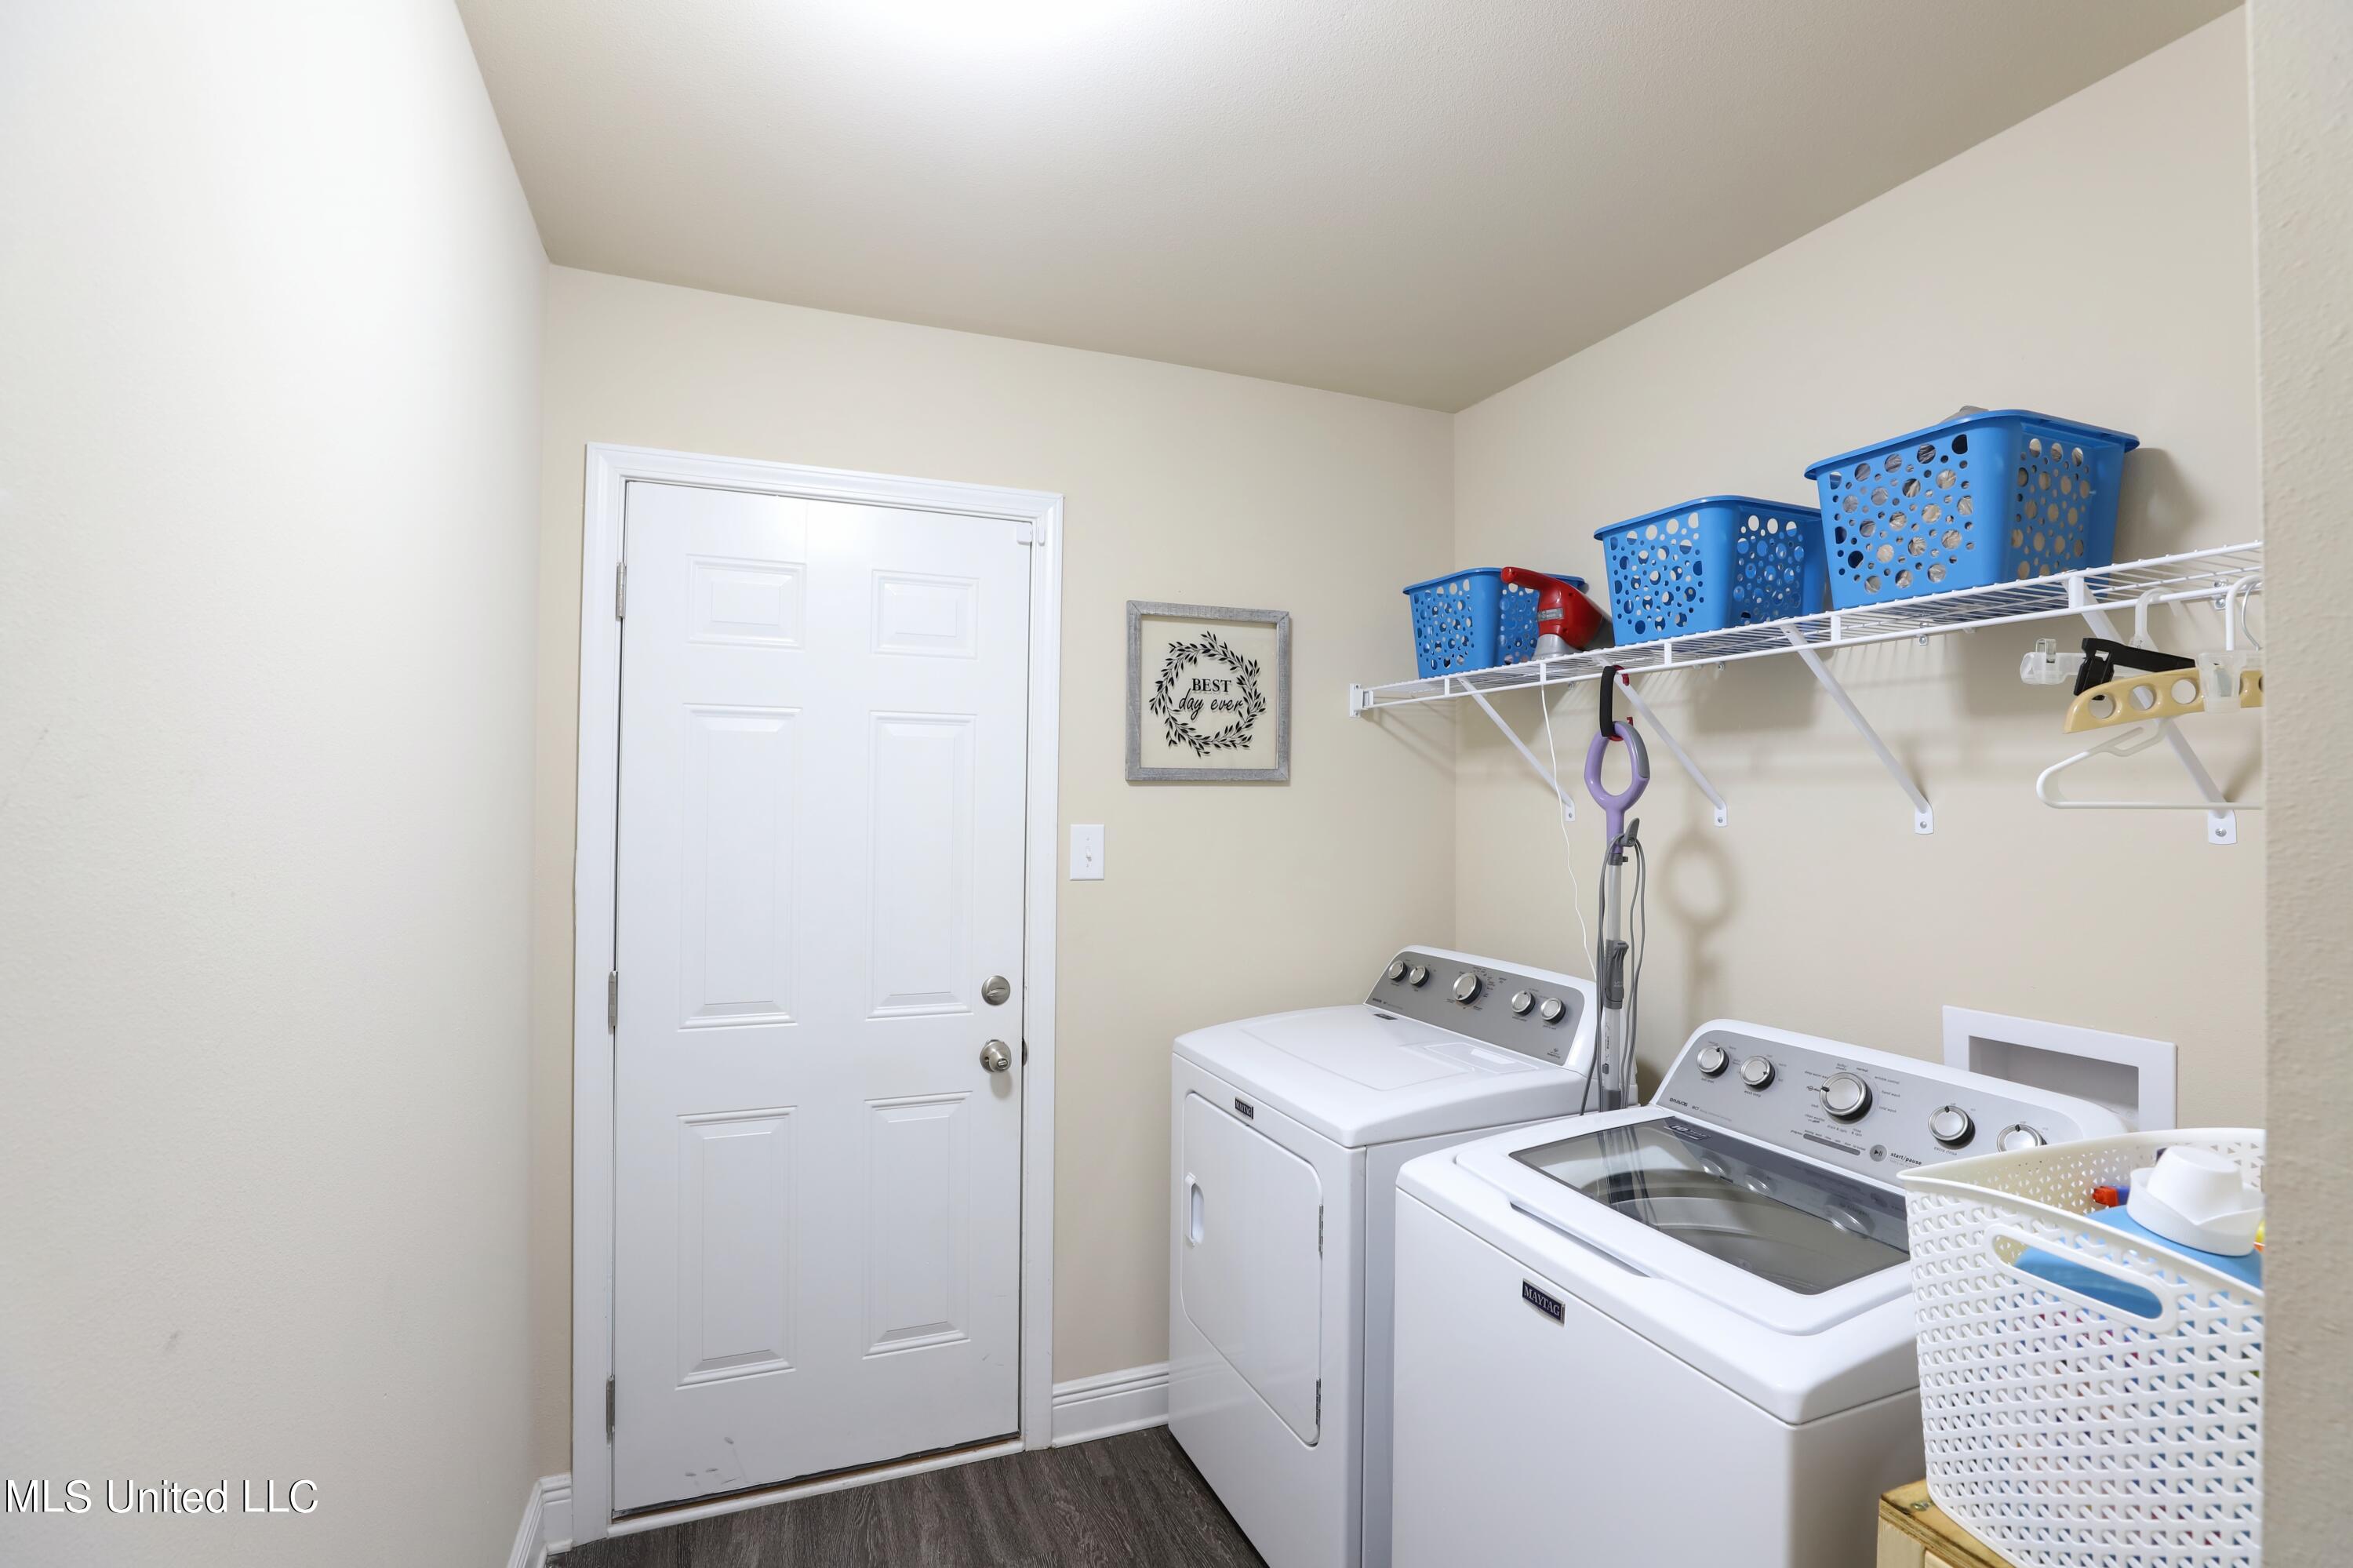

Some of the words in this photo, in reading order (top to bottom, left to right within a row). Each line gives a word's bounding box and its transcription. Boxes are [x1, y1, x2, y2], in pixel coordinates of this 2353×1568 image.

[1191, 678, 1232, 693] BEST
[1178, 687, 1204, 721] day
[1210, 698, 1244, 711] ever
[1890, 1151, 1922, 1166] start/pause
[1524, 1284, 1560, 1317] MAYTAG
